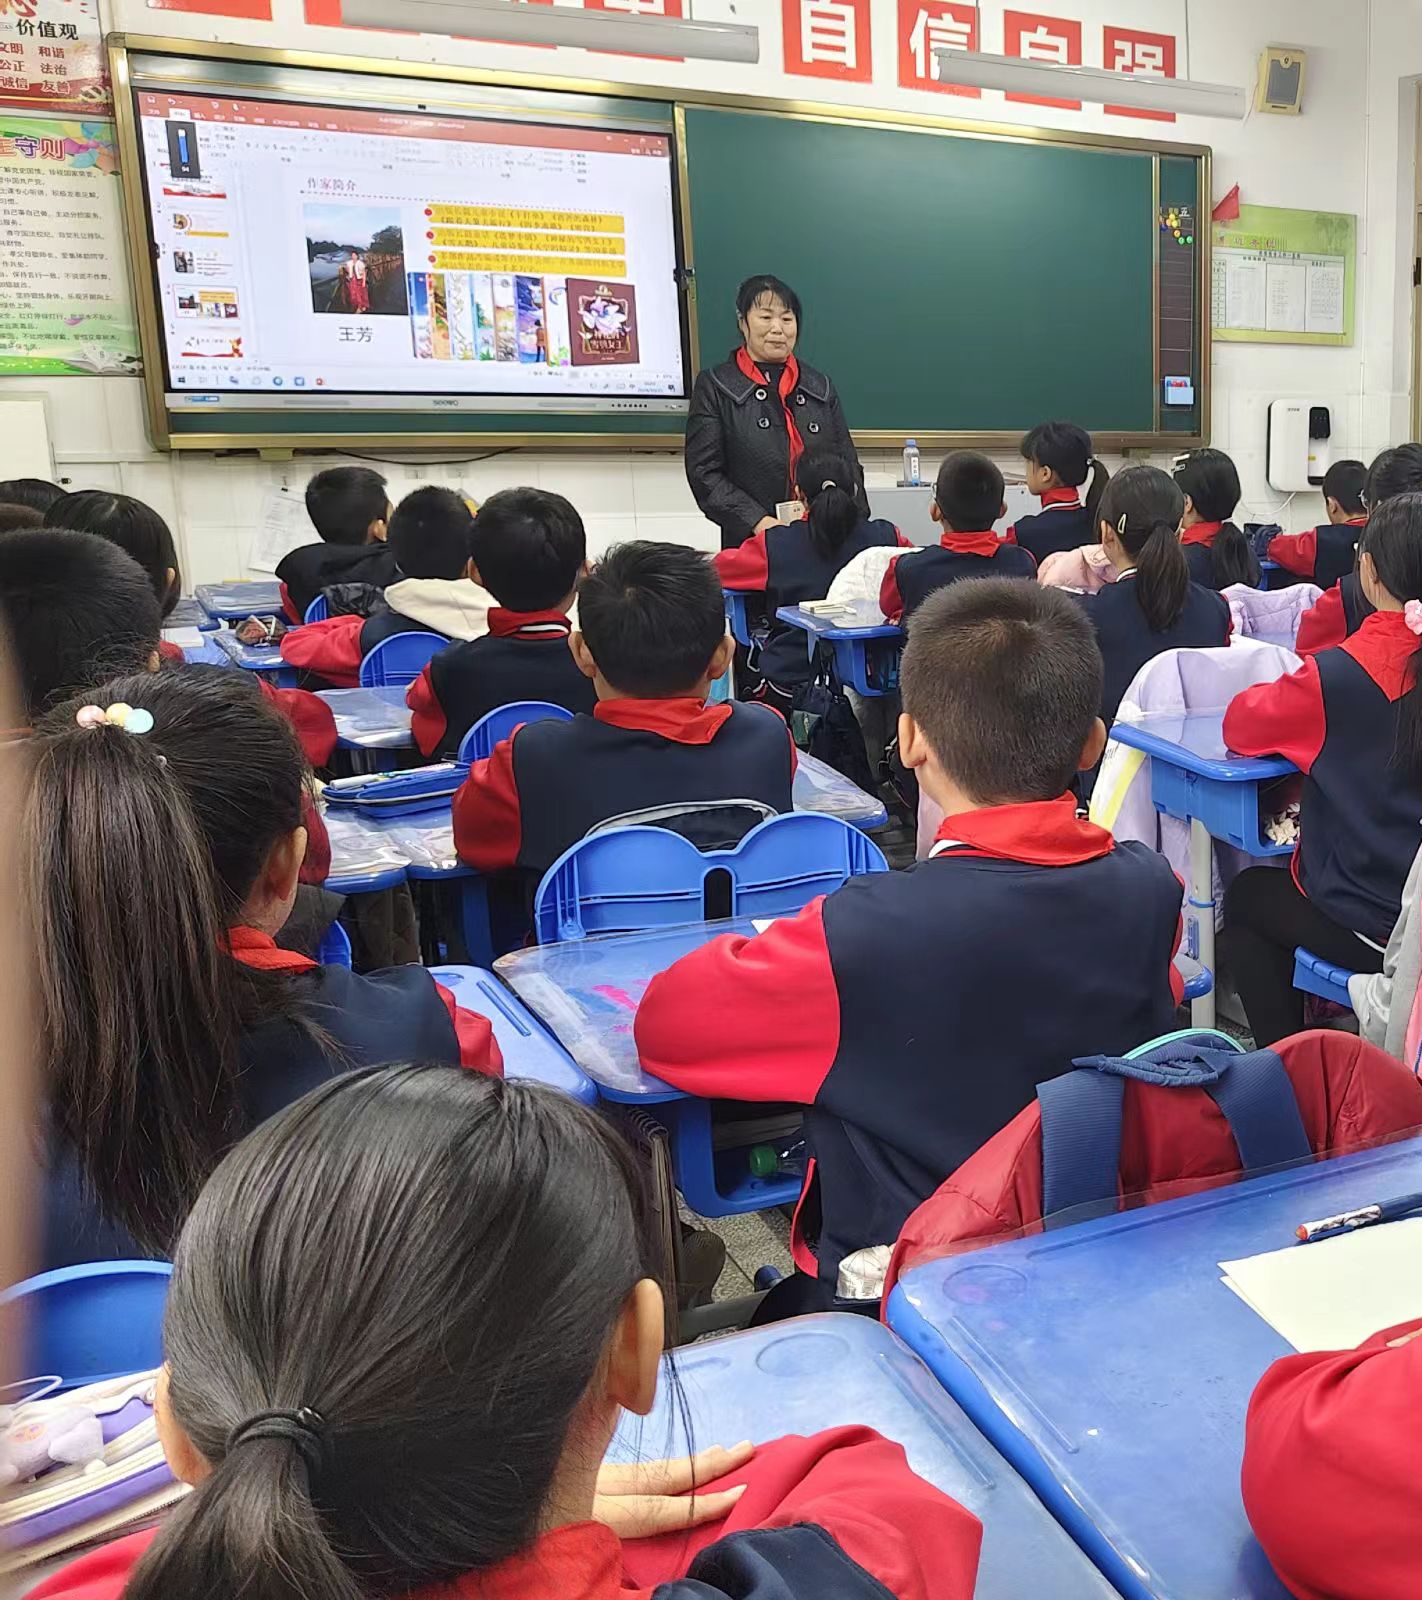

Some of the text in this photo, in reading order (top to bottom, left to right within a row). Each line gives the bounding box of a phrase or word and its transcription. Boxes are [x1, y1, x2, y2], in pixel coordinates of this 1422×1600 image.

[16, 18, 79, 40] 价值观
[40, 62, 68, 76] 法治
[307, 177, 357, 192] 作家简介
[339, 326, 373, 342] 王芳
